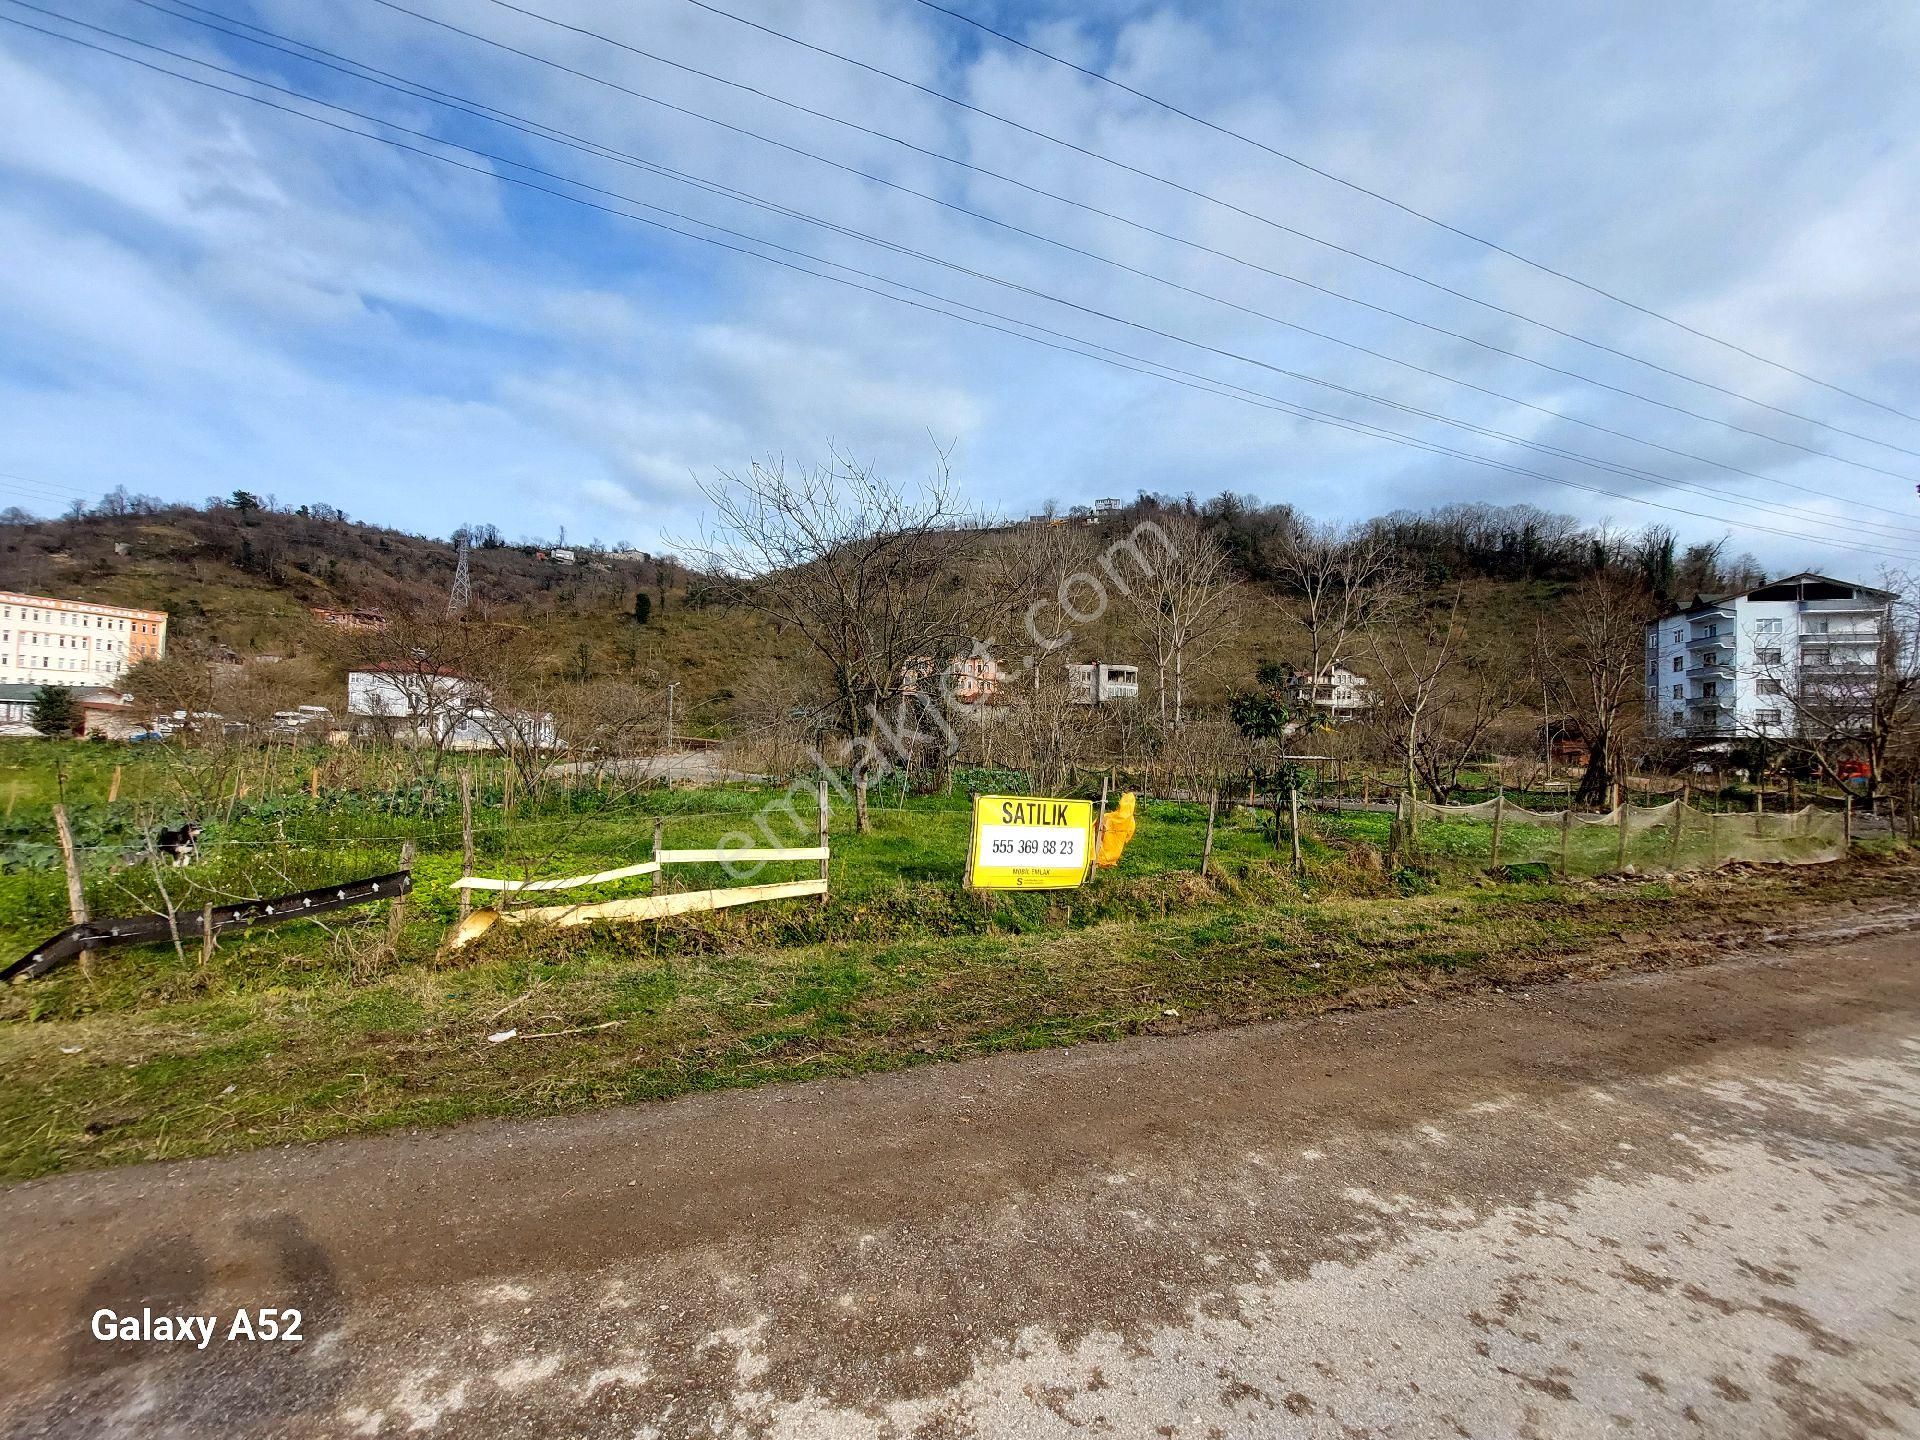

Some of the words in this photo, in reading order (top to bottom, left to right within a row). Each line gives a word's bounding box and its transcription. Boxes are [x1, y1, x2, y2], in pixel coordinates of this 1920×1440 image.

[1002, 801, 1068, 826] SATILIK
[992, 839, 1013, 854] 555
[1017, 839, 1038, 854] 369
[1042, 840, 1056, 855] 88
[1059, 840, 1073, 855] 23
[1031, 868, 1050, 876] EMLAK
